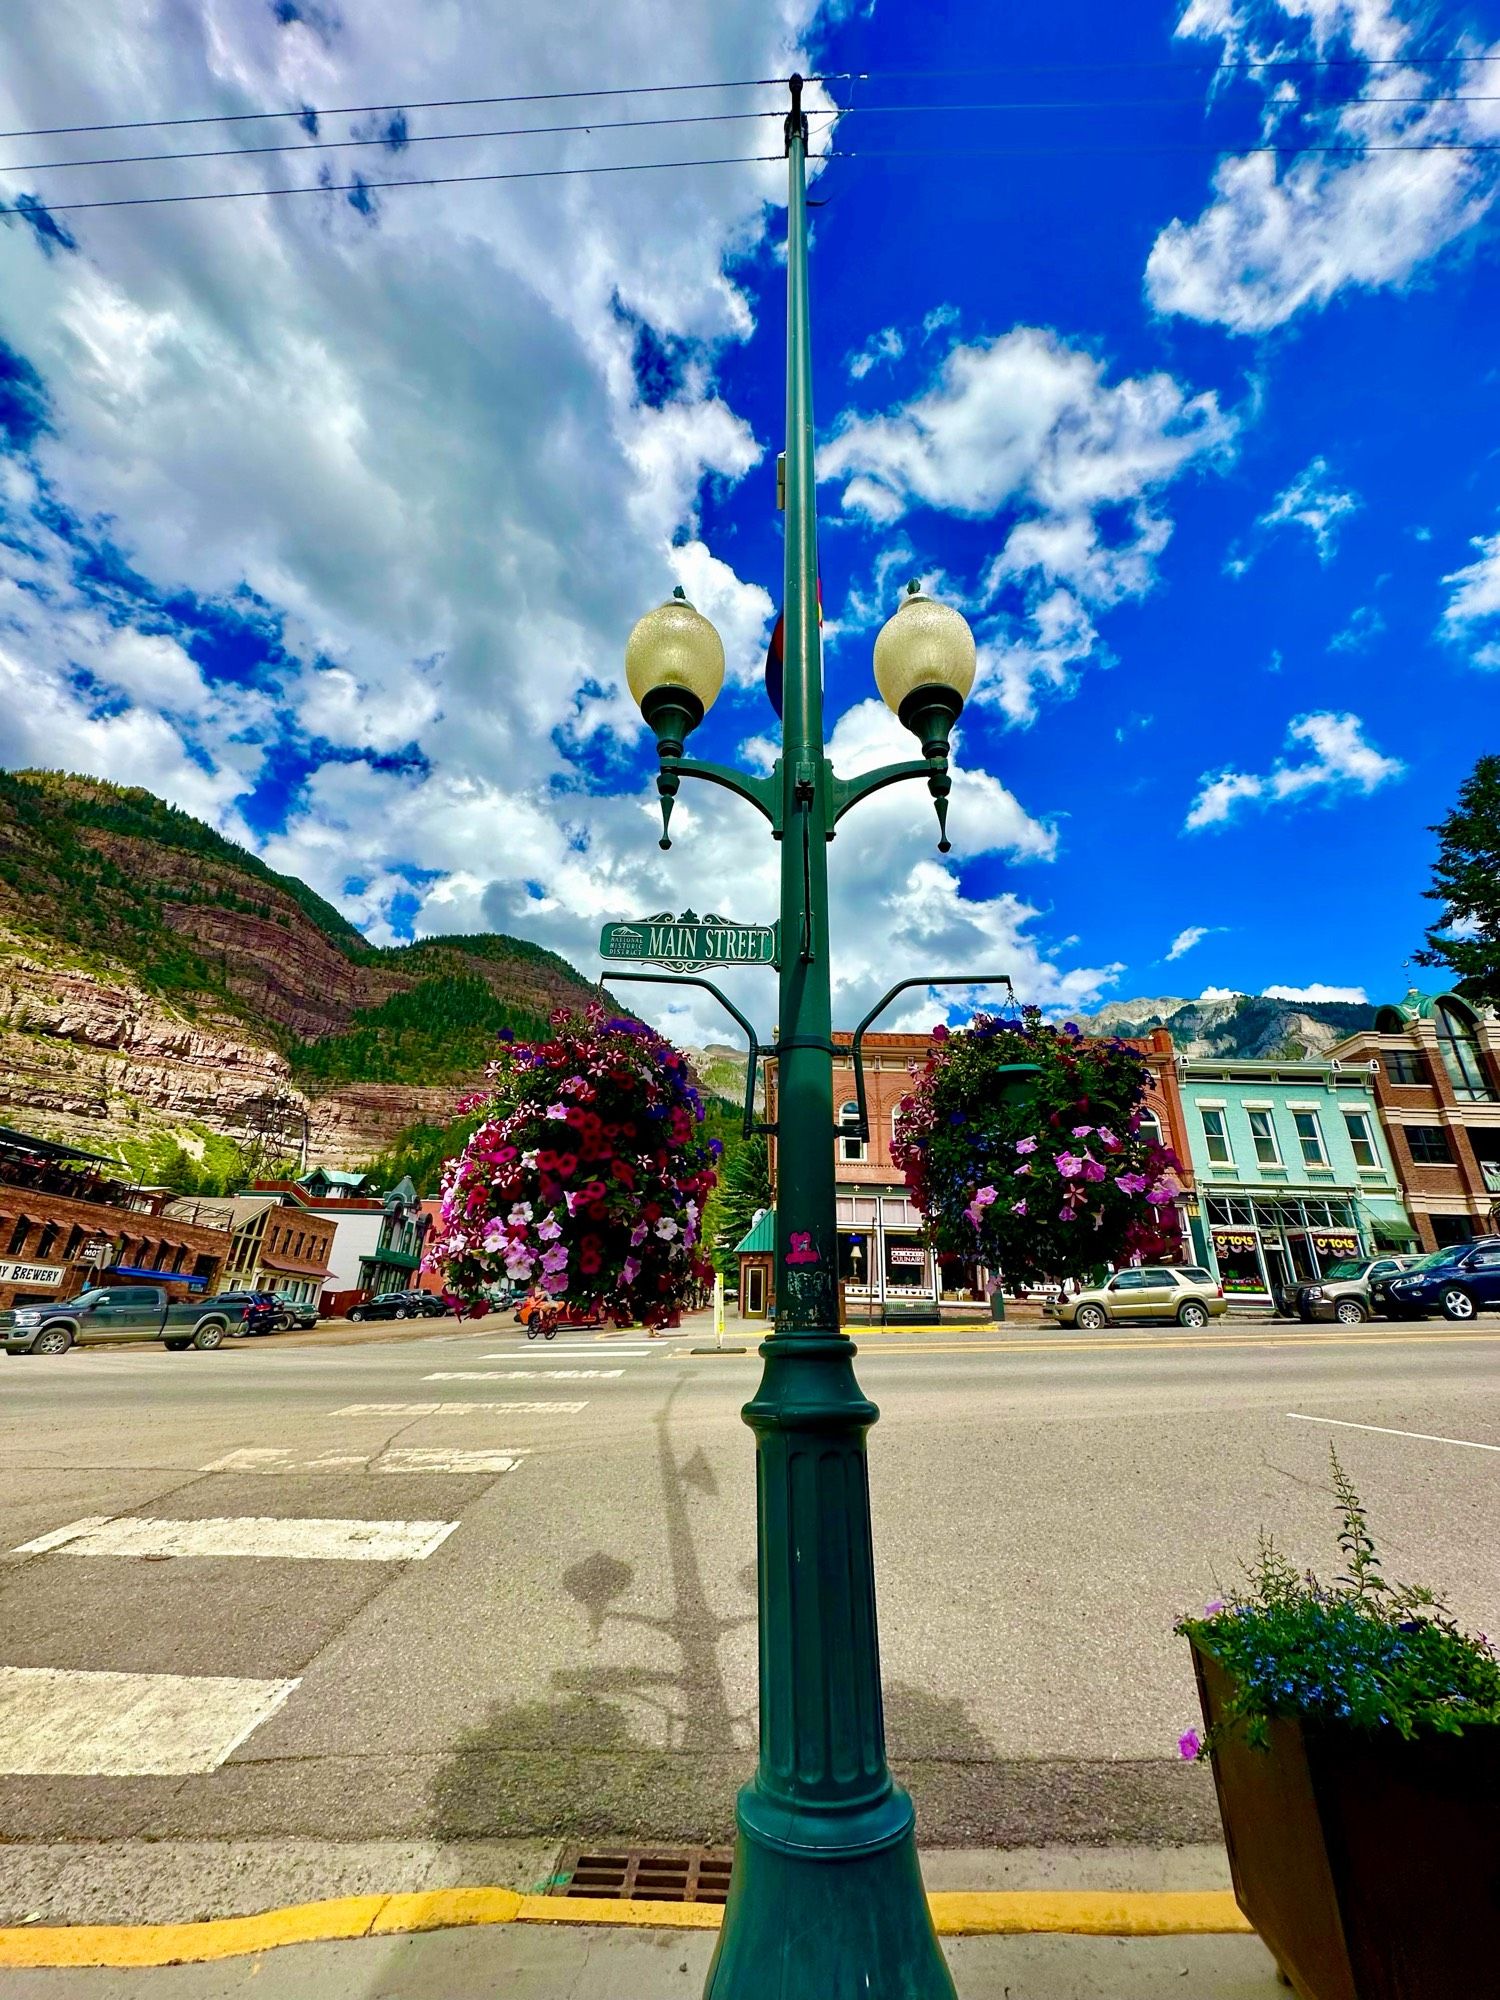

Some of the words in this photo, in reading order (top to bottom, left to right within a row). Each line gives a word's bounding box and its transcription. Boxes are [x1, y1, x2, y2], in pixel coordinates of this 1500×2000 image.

[648, 927, 698, 957] MAIN
[705, 929, 769, 960] STREET
[11, 1266, 59, 1282] BREWERY
